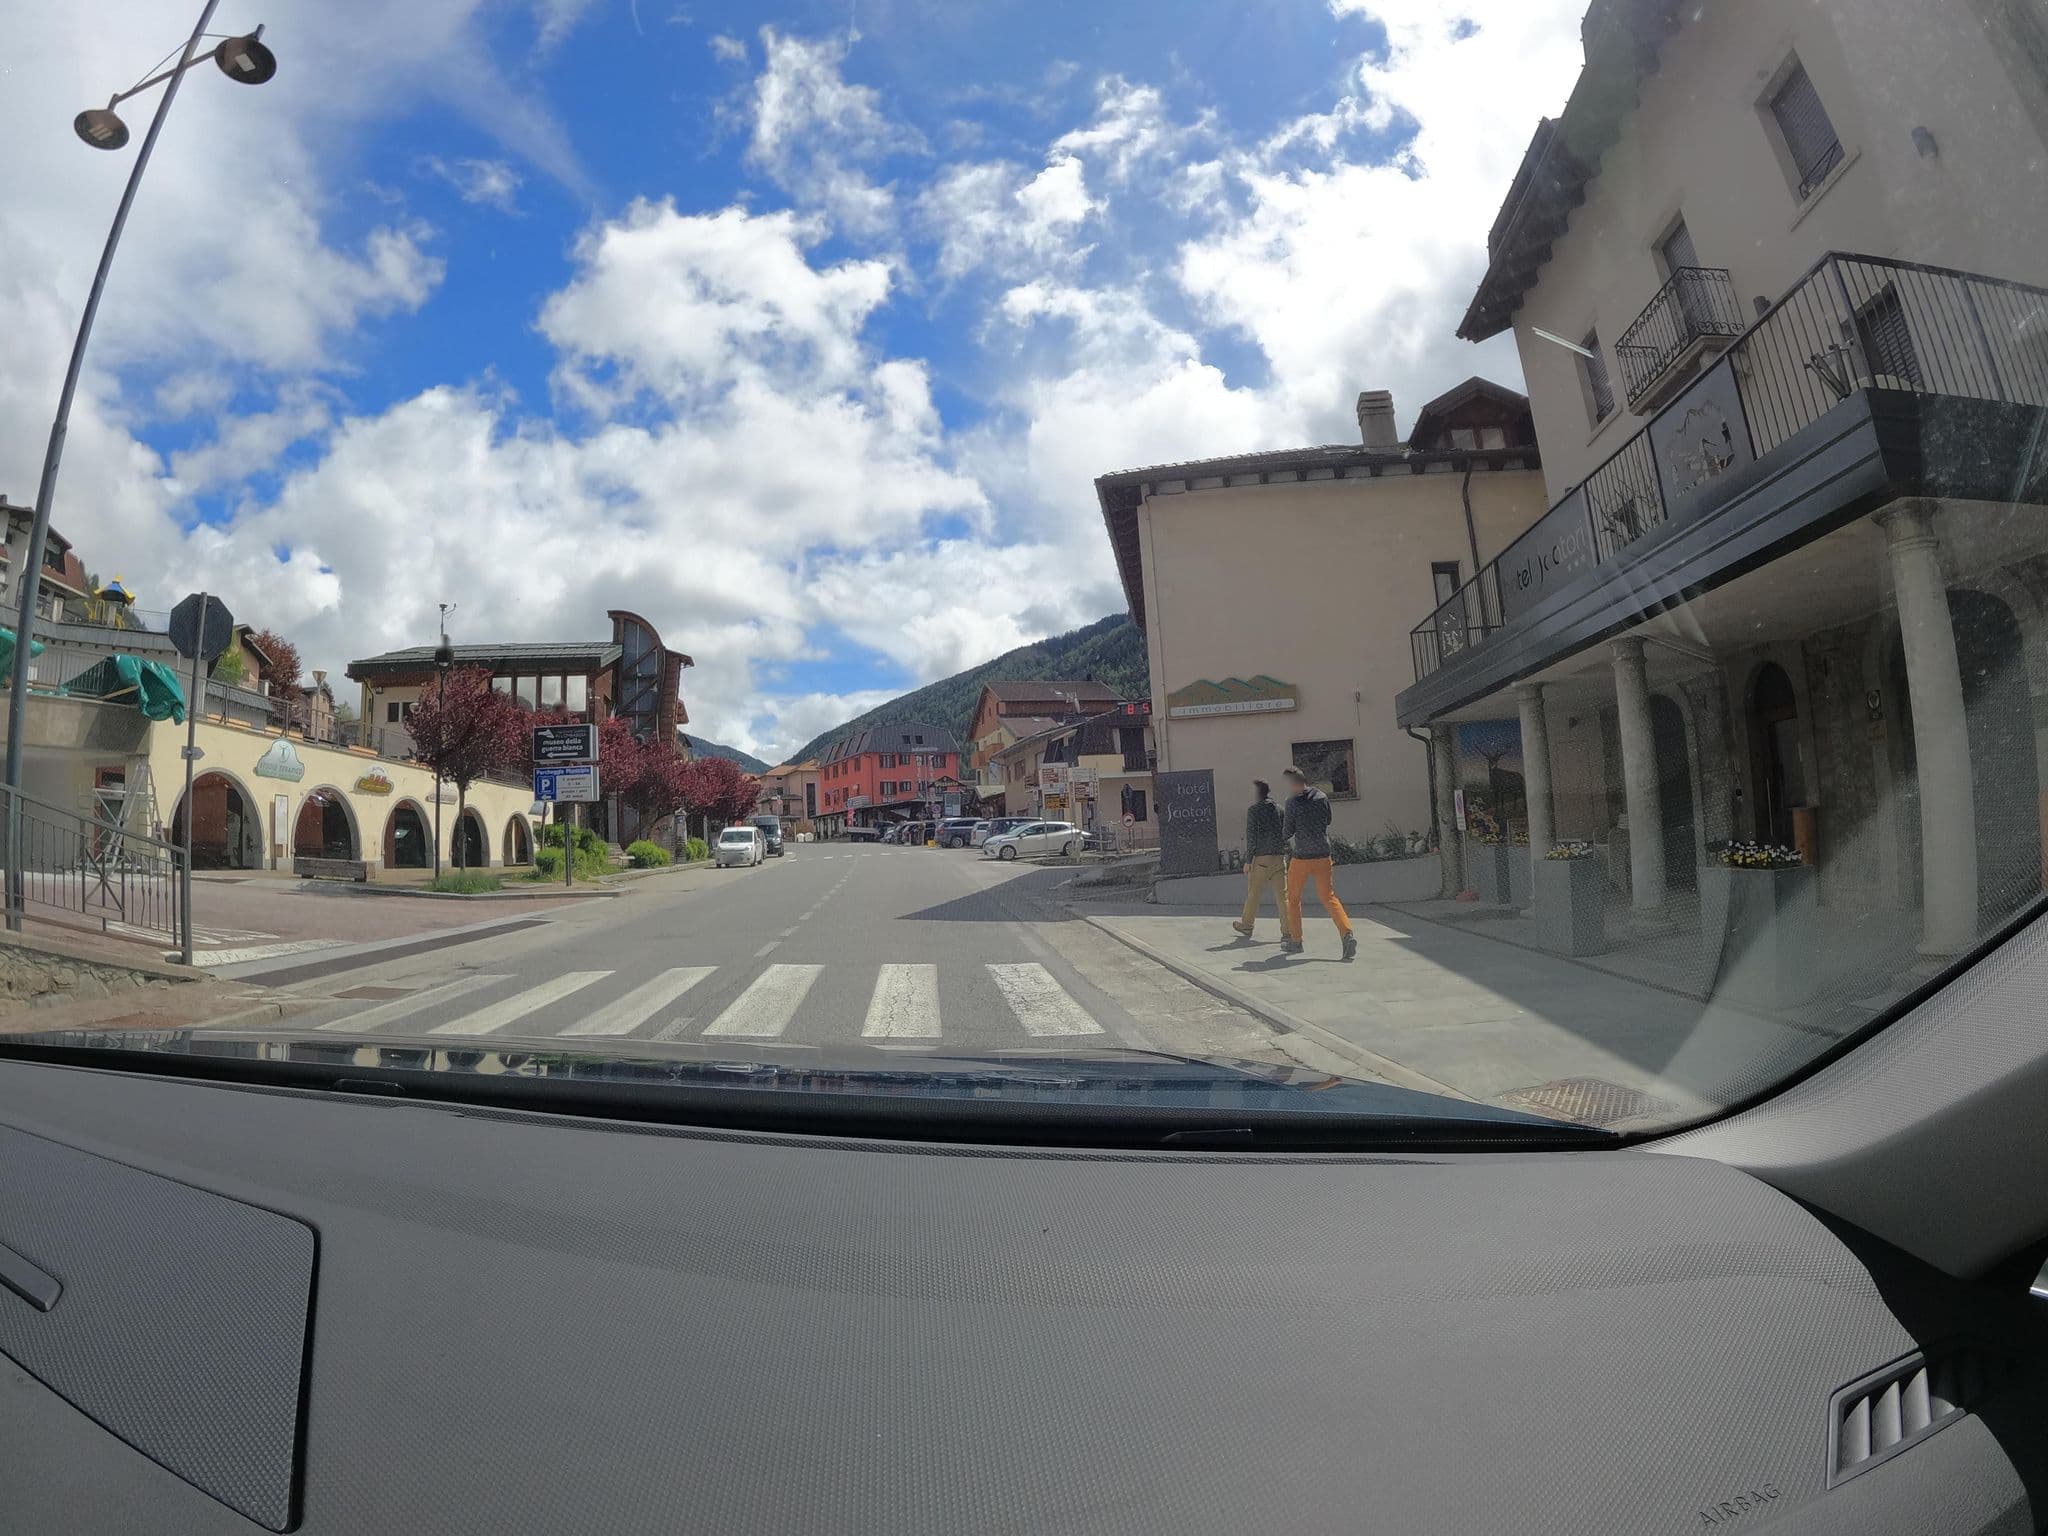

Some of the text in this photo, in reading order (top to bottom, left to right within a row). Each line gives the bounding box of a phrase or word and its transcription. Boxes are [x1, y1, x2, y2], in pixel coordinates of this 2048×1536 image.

[1182, 700, 1283, 715] immobiliare
[1177, 781, 1210, 795] hotel
[1698, 1482, 1783, 1529] AIRBAG
